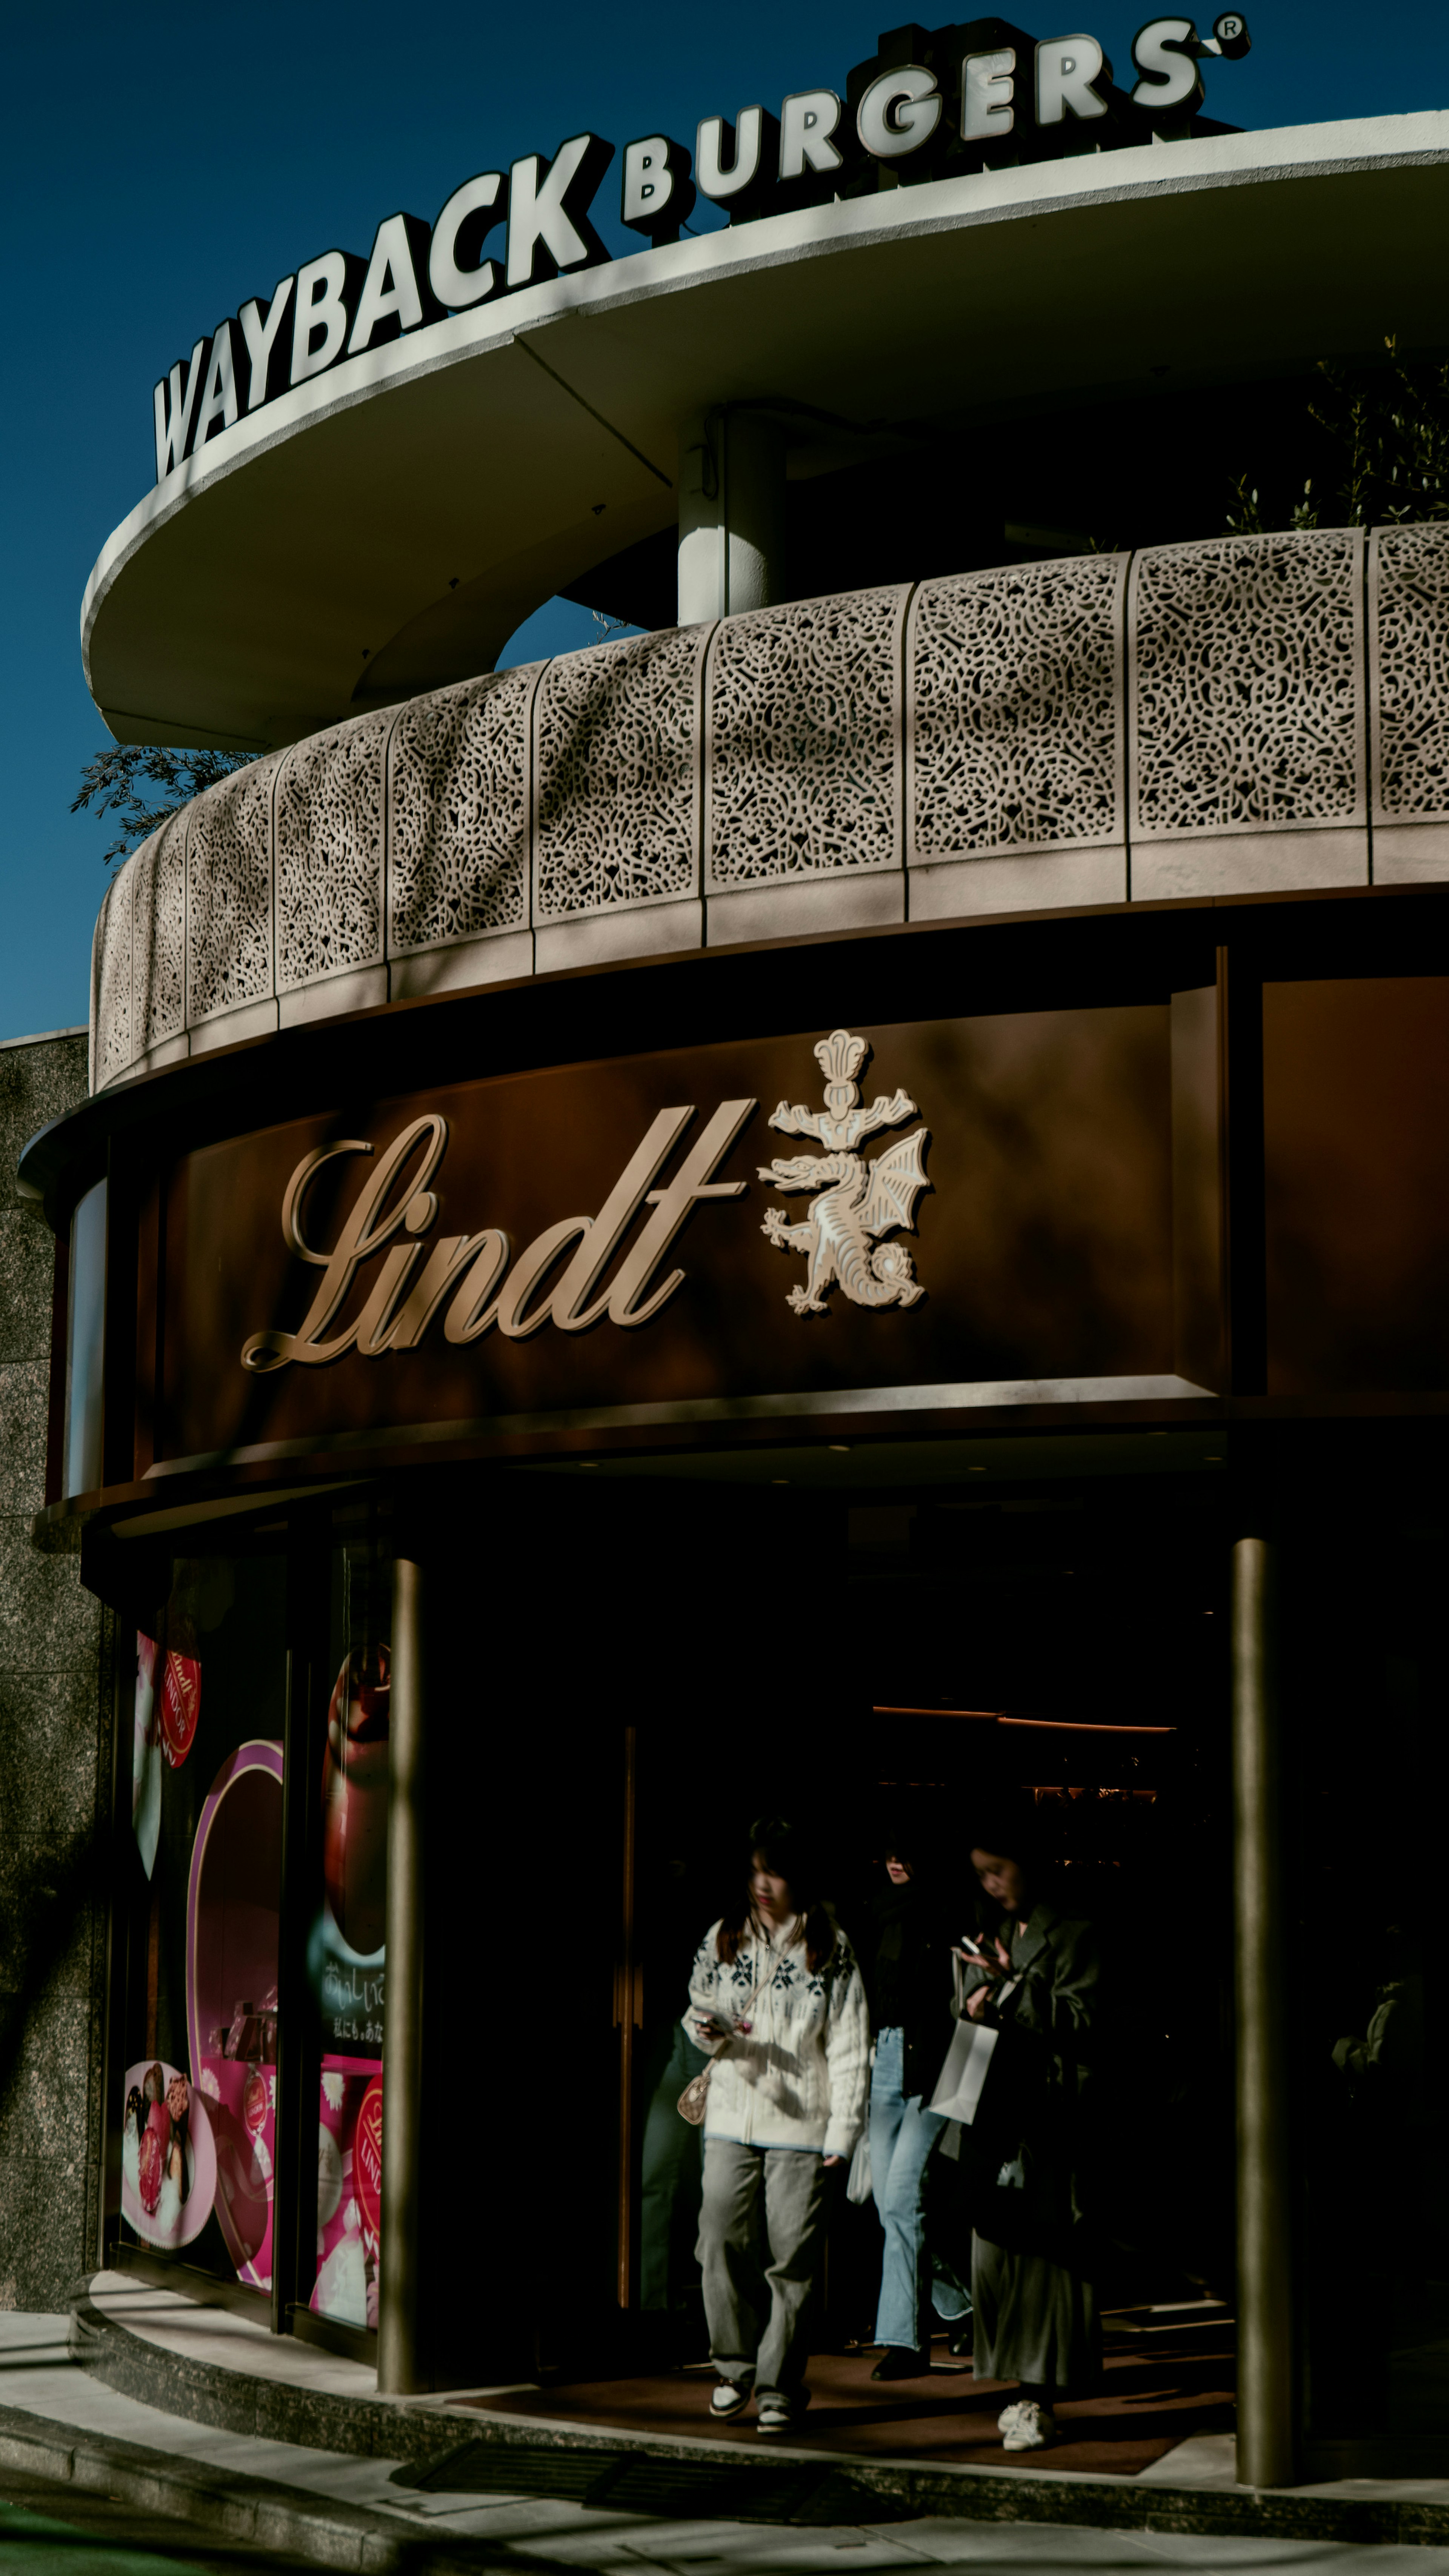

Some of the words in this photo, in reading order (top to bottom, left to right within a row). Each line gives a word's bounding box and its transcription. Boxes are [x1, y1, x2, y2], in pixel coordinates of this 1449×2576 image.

[153, 134, 591, 482] WAYBACK
[623, 17, 1195, 225] BURGERS
[241, 1098, 757, 1373] Lindt
[163, 1663, 186, 1740] LINDOR
